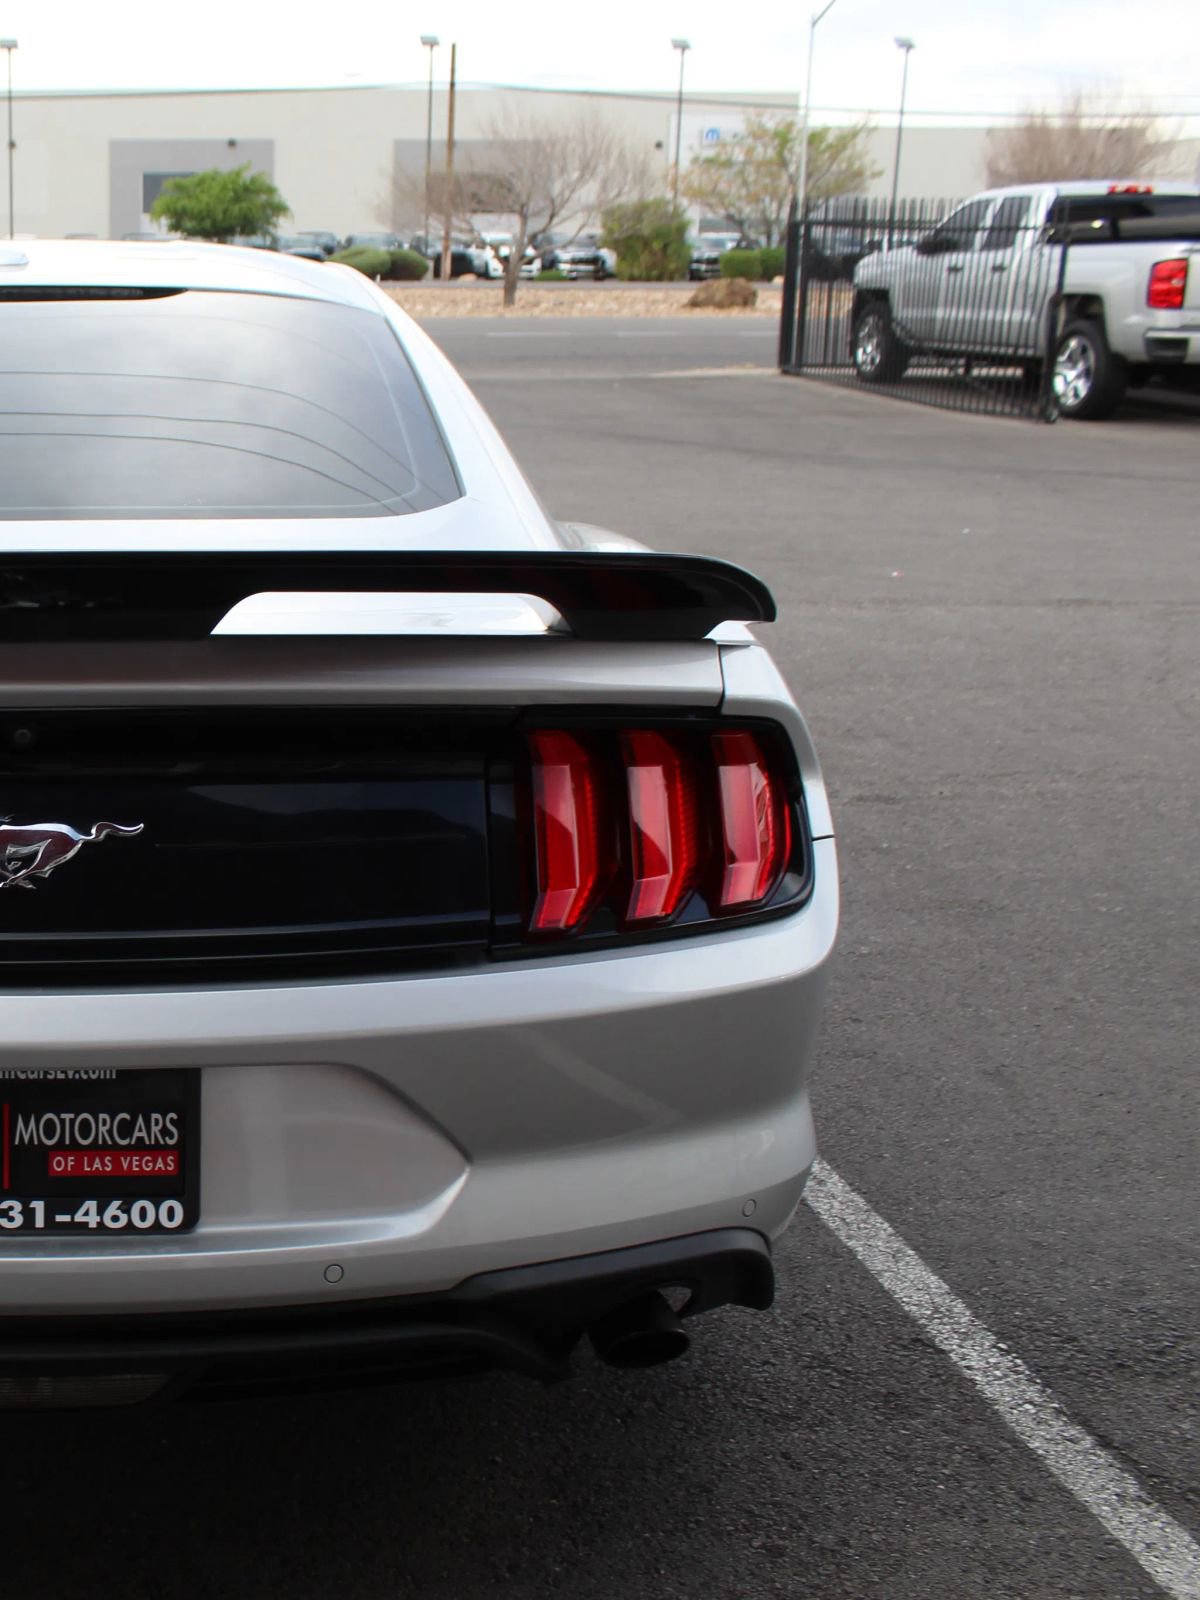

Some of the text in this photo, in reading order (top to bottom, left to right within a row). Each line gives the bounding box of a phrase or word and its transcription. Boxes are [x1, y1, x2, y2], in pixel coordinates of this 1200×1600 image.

[15, 1112, 179, 1146] MOTORCARS
[52, 1156, 176, 1172] OF LAS VEGAS
